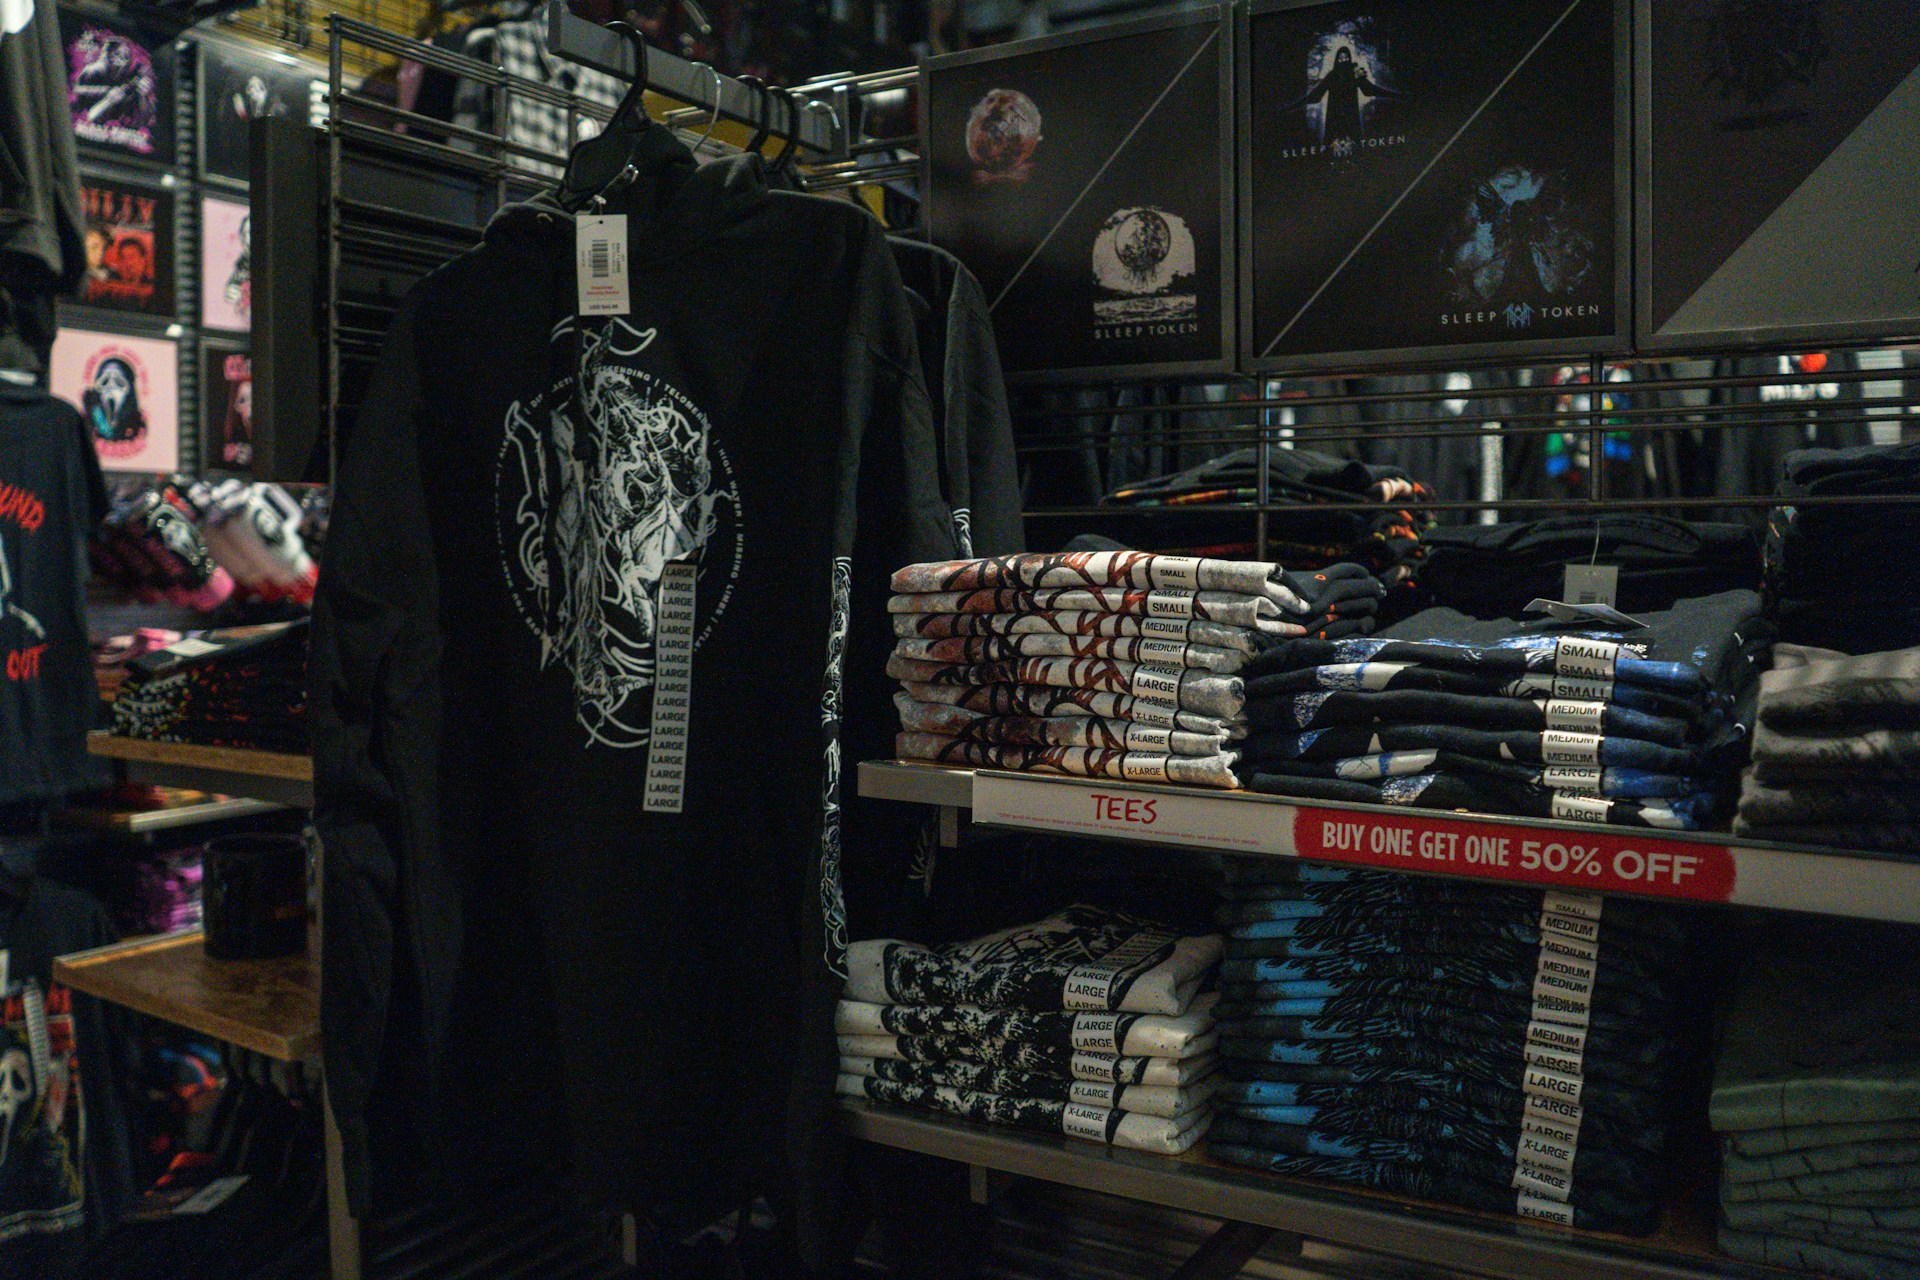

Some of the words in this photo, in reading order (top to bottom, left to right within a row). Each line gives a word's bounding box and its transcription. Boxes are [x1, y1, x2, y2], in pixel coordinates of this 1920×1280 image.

[1282, 145, 1326, 158] SLEEP
[1360, 135, 1406, 147] TOKEN
[1441, 311, 1497, 325] SLEEP
[1541, 304, 1599, 318] TOKEN
[1095, 325, 1143, 340] SLEEP
[1149, 323, 1198, 335] TOKEN
[665, 568, 694, 578] LARGE
[1160, 569, 1186, 578] SMALL
[663, 582, 693, 592] LARGE
[1154, 589, 1189, 598] SMALL
[662, 596, 693, 606] LARGE
[1152, 603, 1188, 614] SMALL
[661, 610, 692, 621] LARGE
[660, 625, 691, 635] LARGE
[1144, 621, 1183, 633] MEDIUM
[660, 640, 690, 650] LARGE
[1143, 642, 1182, 653] MEDIUM
[6, 643, 49, 671] OUT
[1561, 644, 1611, 661] SMALL
[660, 654, 690, 664] LARGE
[659, 669, 689, 678] LARGE
[1141, 664, 1181, 676] LARGE
[1560, 664, 1608, 677] SMALL
[658, 683, 688, 693] LARGE
[1136, 677, 1175, 693] LARGE
[1558, 685, 1609, 699] SMALL
[656, 698, 687, 707] LARGE
[655, 712, 686, 721] LARGE
[1551, 705, 1598, 716] MEDIUM
[1136, 712, 1170, 725] X-LARGE
[654, 726, 685, 736] LARGE
[1551, 724, 1599, 735] MEDIUM
[1130, 733, 1165, 745] X-LARGE
[1547, 734, 1594, 744] MEDIUM
[653, 741, 684, 751] LARGE
[651, 755, 683, 765] LARGE
[1547, 752, 1594, 764] MEDIUM
[650, 769, 682, 779] LARGE
[1127, 766, 1161, 776] X-LARGE
[1550, 767, 1596, 778] LARGE
[648, 783, 680, 794] LARGE
[647, 798, 679, 808] LARGE
[1091, 794, 1158, 825] TEES
[1557, 806, 1603, 823] LARGE
[1322, 820, 1362, 851] BUY
[1369, 825, 1413, 857] ONE
[1419, 830, 1459, 862] GET
[1465, 835, 1511, 867] ONE
[1519, 840, 1602, 876] 50%
[1613, 849, 1698, 885] OFF
[1545, 917, 1594, 937] MEDIUM
[1543, 960, 1590, 979] MEDIUM
[1073, 970, 1112, 982] LARGE
[1540, 975, 1588, 993] MEDIUM
[1068, 983, 1106, 999] LARGE
[1067, 1000, 1105, 1011] LARGE
[1076, 1021, 1114, 1031] LARGE
[1075, 1037, 1113, 1048] LARGE
[1532, 1027, 1580, 1047] MEDIUM
[1077, 1050, 1114, 1063] LARGE
[1526, 1052, 1579, 1073] LARGE
[1074, 1063, 1112, 1078] LARGE
[1529, 1073, 1578, 1096] LARGE
[1073, 1086, 1109, 1099] X-LARGE
[1531, 1096, 1579, 1119] LARGE
[1068, 1107, 1104, 1122] X-LARGE
[1066, 1124, 1102, 1138] X-LARGE
[1526, 1122, 1574, 1143] LARGE
[1524, 1138, 1569, 1161] X-LARGE
[1521, 1167, 1566, 1189] X-LARGE
[1522, 1207, 1567, 1223] X-LARGE
